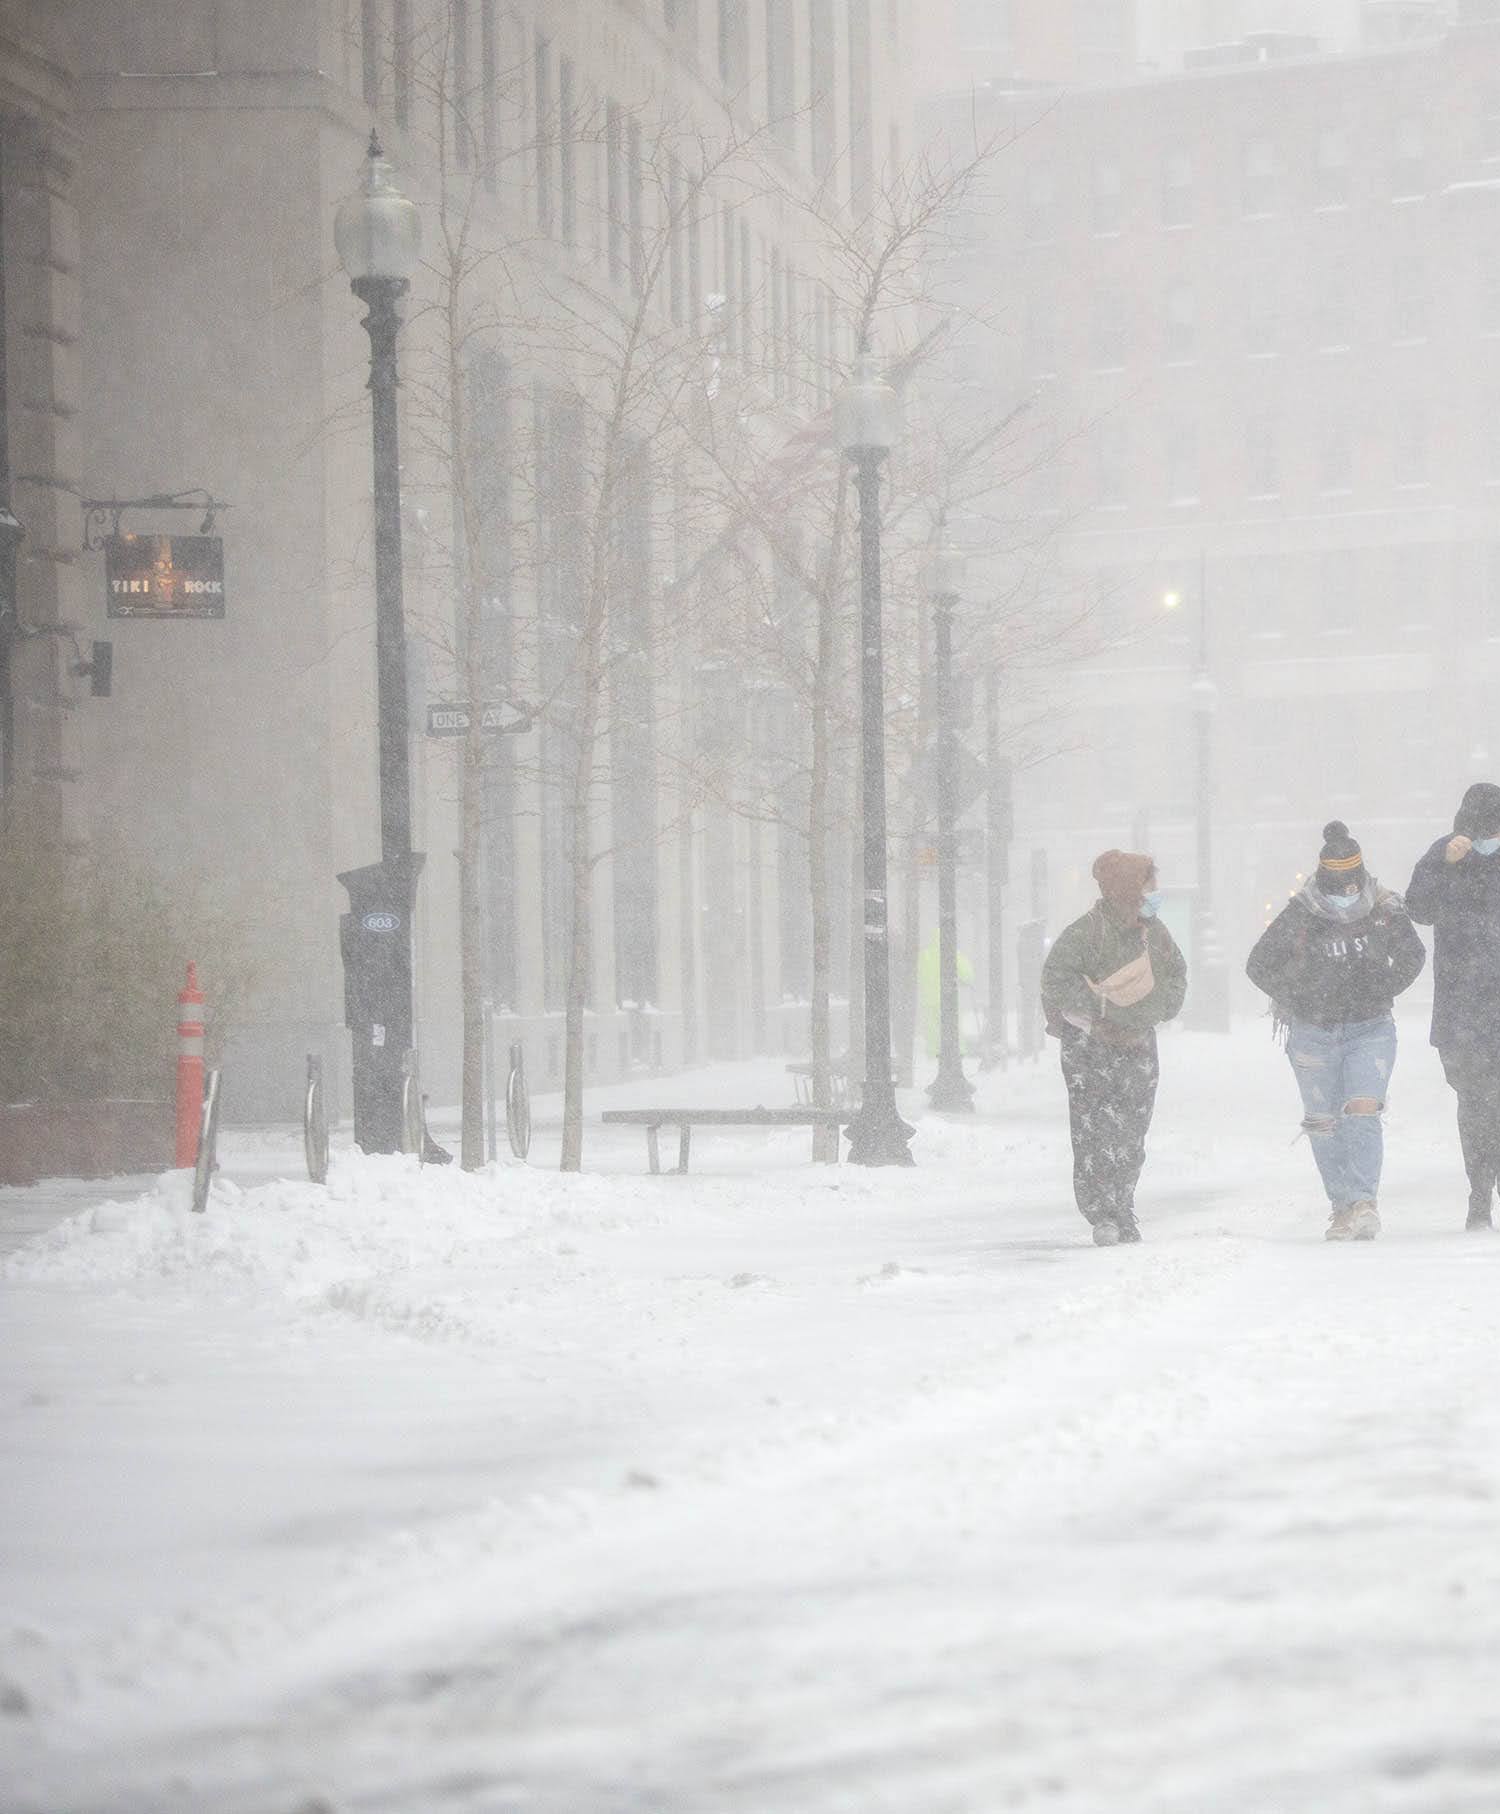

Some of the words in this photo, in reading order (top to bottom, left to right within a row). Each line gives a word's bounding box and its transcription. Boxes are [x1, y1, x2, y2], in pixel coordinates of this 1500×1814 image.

[112, 579, 149, 593] TIKI
[184, 579, 222, 593] ROCK
[435, 712, 466, 728] ONE
[478, 710, 504, 727] AY
[368, 917, 393, 929] 603
